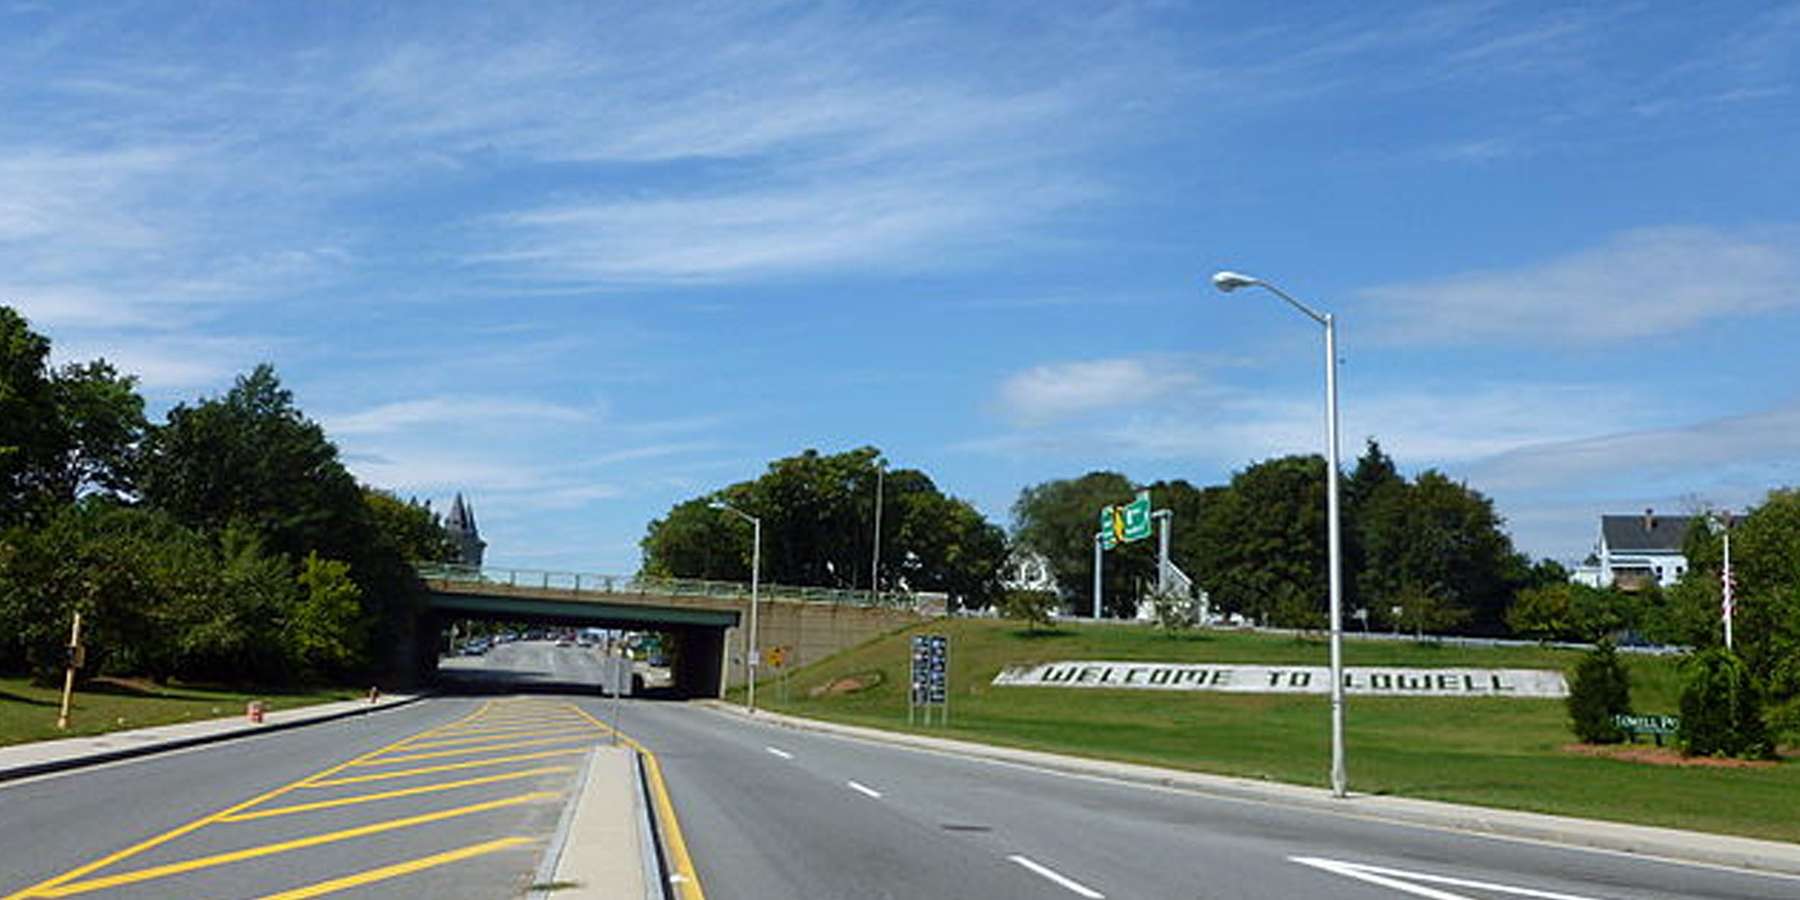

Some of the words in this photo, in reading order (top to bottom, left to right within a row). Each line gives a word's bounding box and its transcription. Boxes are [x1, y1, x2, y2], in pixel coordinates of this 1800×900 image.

[1041, 666, 1234, 685] WELCOME
[1267, 670, 1312, 687] TO
[1344, 674, 1516, 690] LOWELL
